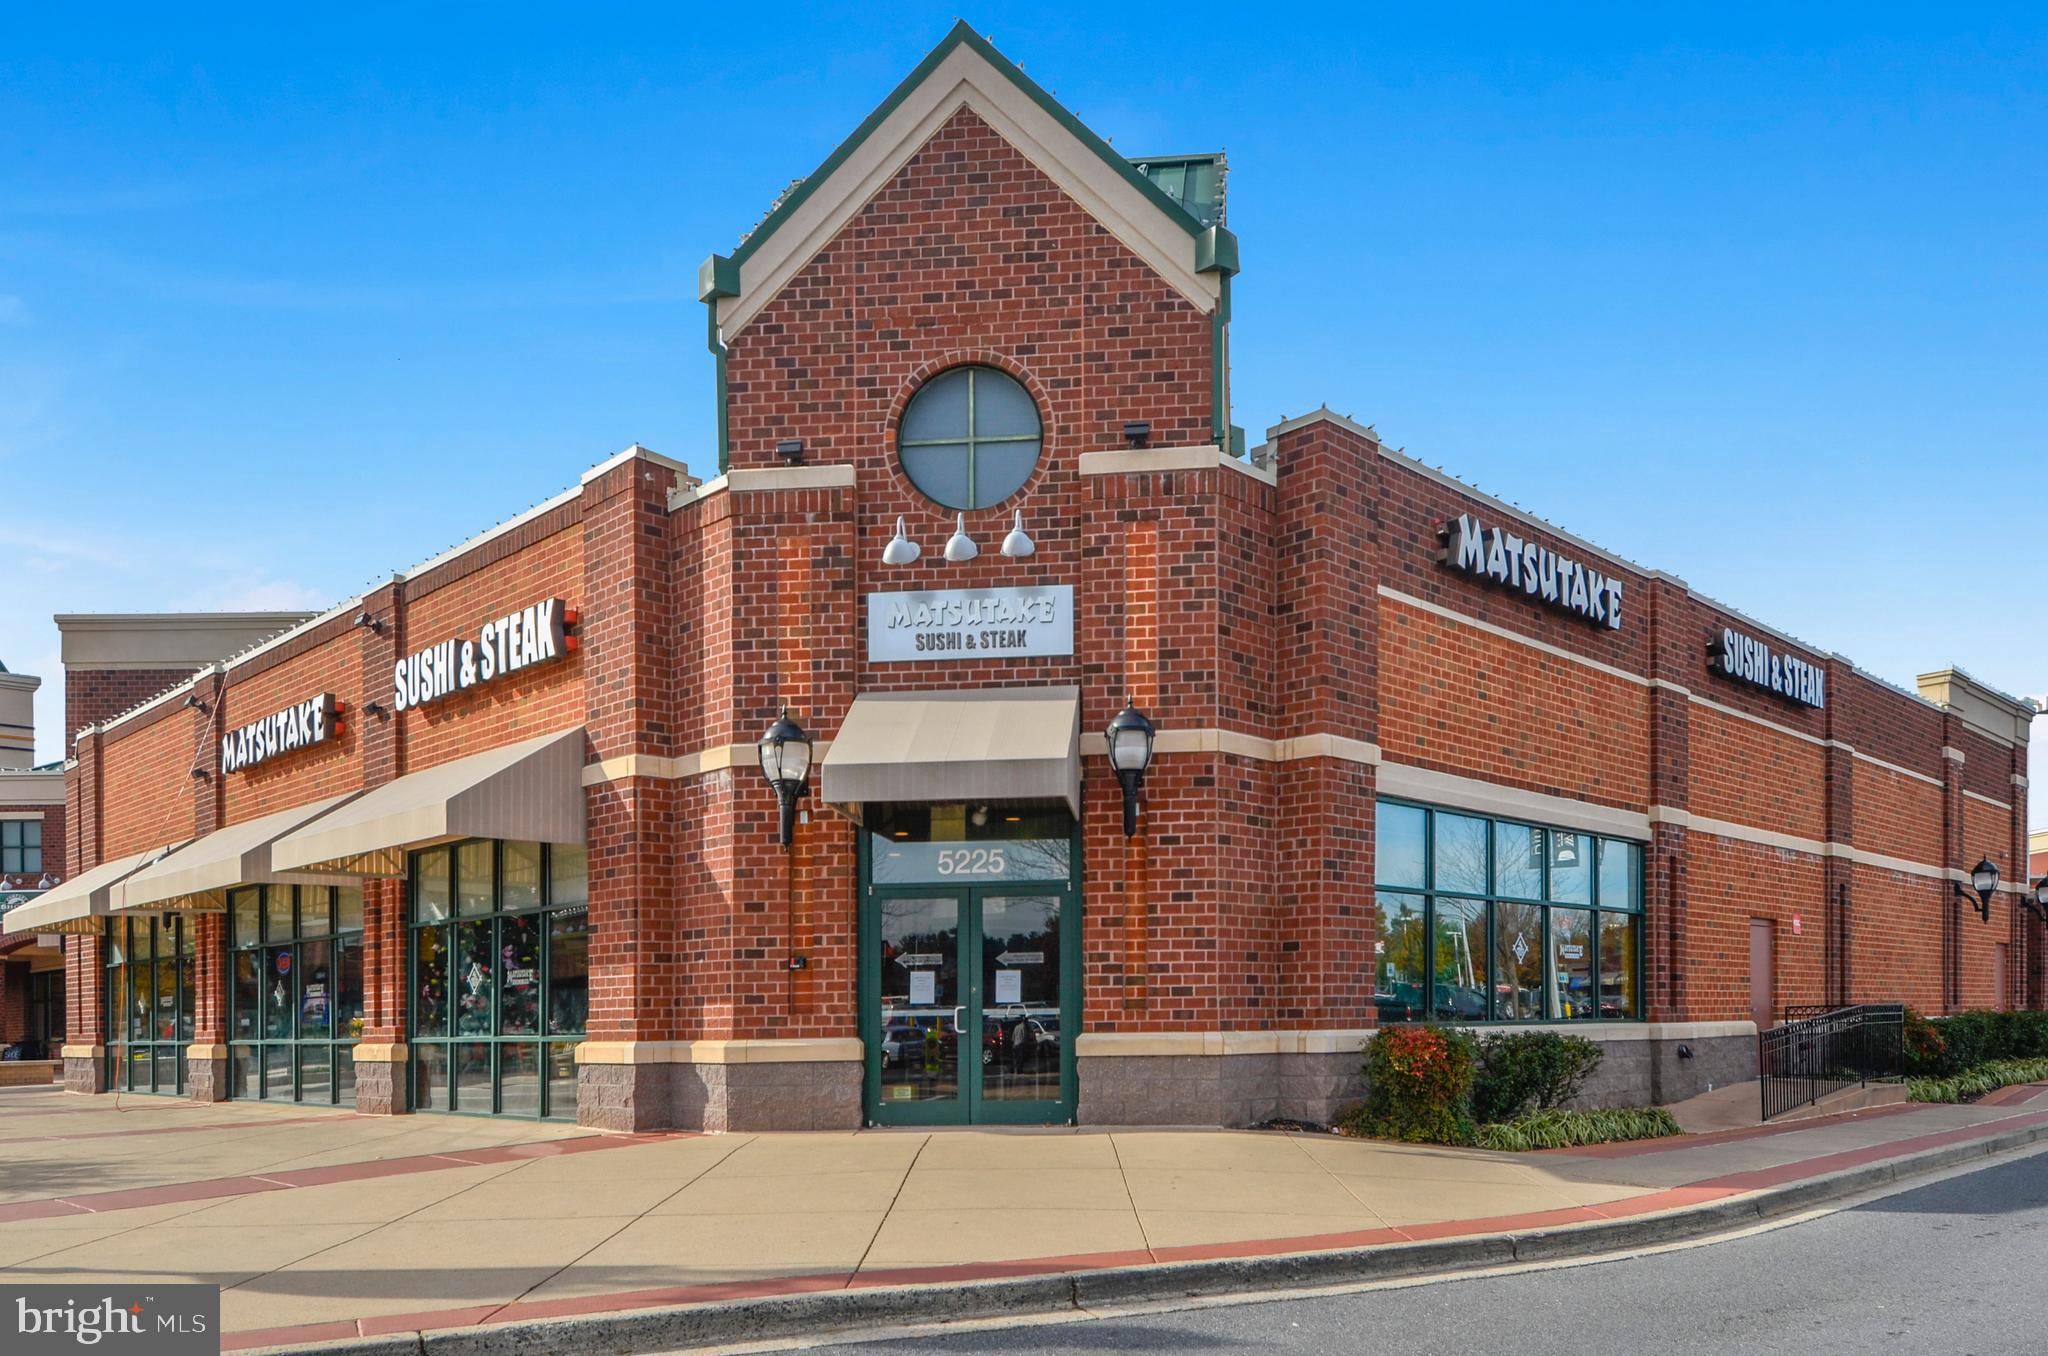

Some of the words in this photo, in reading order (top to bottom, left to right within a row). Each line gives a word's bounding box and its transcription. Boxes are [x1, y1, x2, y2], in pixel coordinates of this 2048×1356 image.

[1458, 514, 1622, 630] MATSUTAKE
[888, 596, 1056, 629] MATSUTAKE
[915, 632, 962, 651] SUSHI
[965, 635, 977, 650] &
[979, 630, 1027, 649] STEAK
[395, 639, 457, 712] SUSHI
[459, 640, 477, 687] &
[480, 598, 557, 676] STEAK
[1724, 628, 1770, 687] SUSHI
[1772, 655, 1783, 692] &
[1784, 654, 1824, 708] STEAK
[222, 692, 326, 773] MATSUTAKE
[938, 850, 1005, 875] 5225
